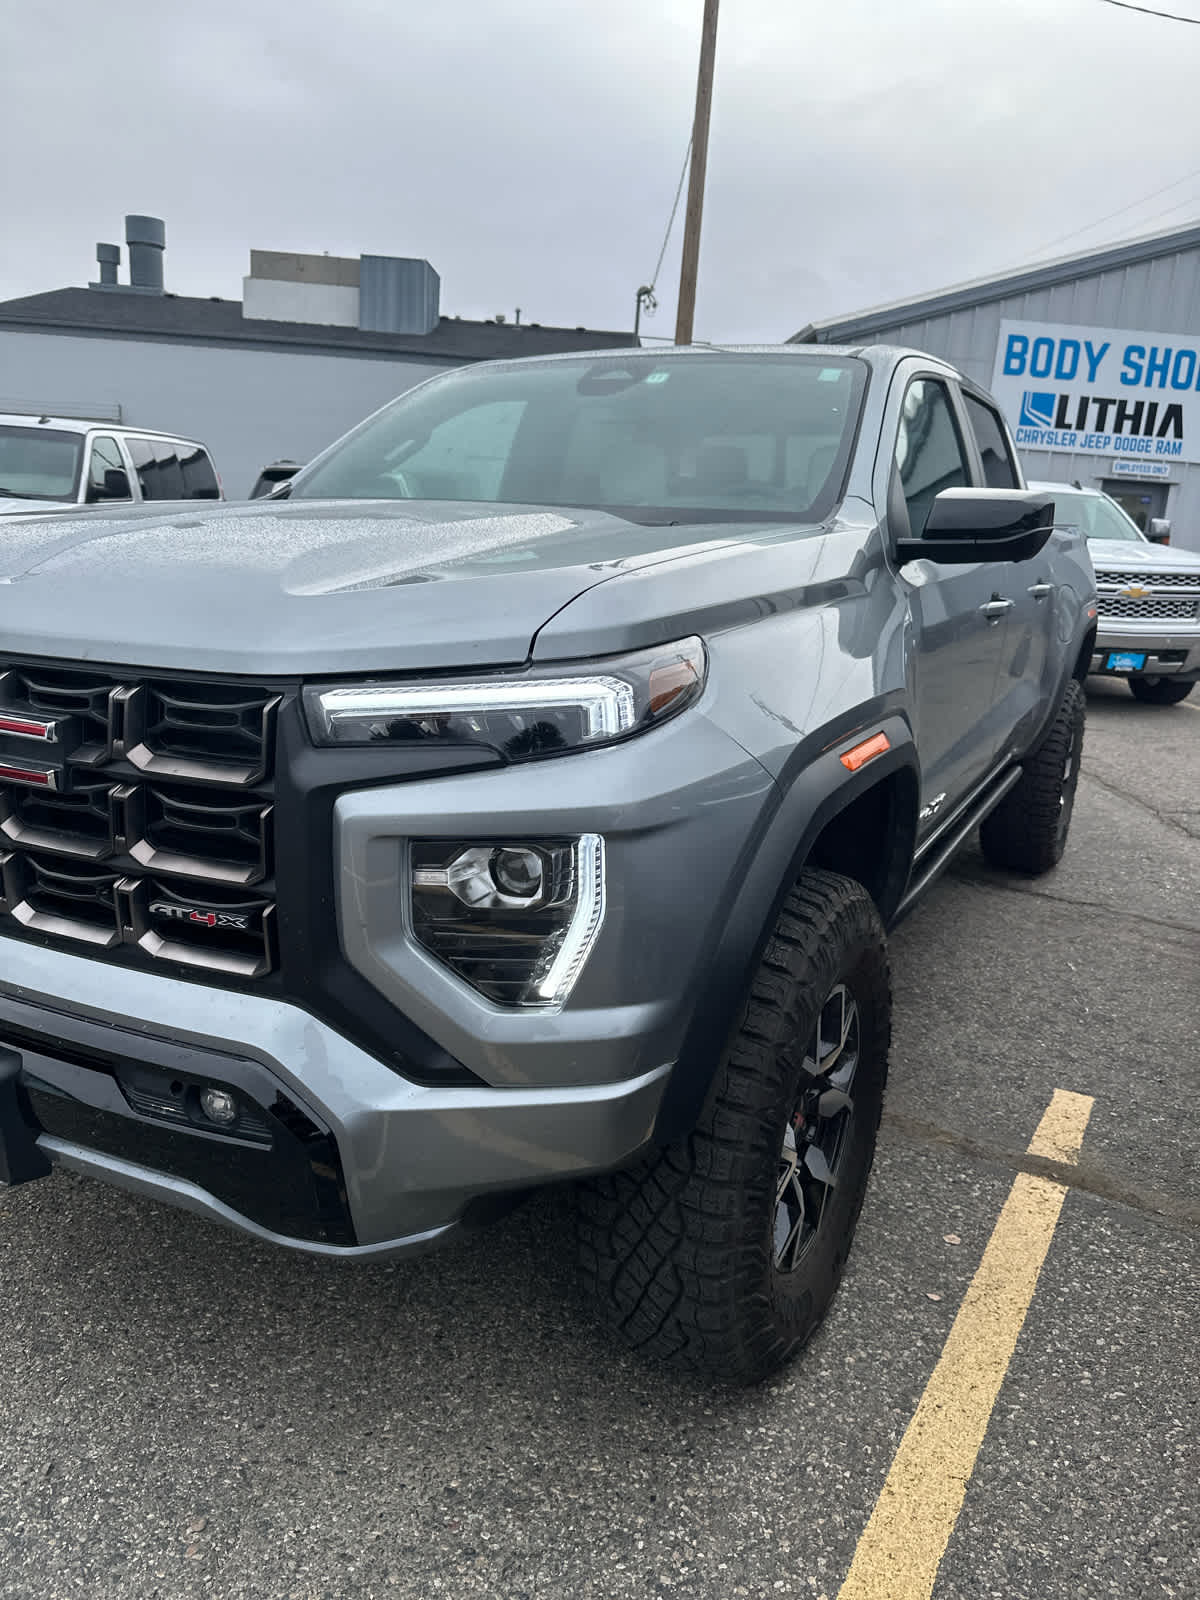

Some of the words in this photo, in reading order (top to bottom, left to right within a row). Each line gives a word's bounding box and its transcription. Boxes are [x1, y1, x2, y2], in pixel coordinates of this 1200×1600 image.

[1003, 334, 1111, 383] BODY
[1120, 345, 1200, 392] SHO
[1055, 394, 1183, 439] LITHIA
[1016, 428, 1077, 447] CHRYSLER
[1080, 434, 1111, 450] JEEP
[1114, 437, 1153, 454] DODGE
[1155, 440, 1183, 456] RAM
[1114, 463, 1151, 473] EMPLOYEES
[1151, 465, 1168, 475] ONLY
[149, 903, 247, 929] AT4X
